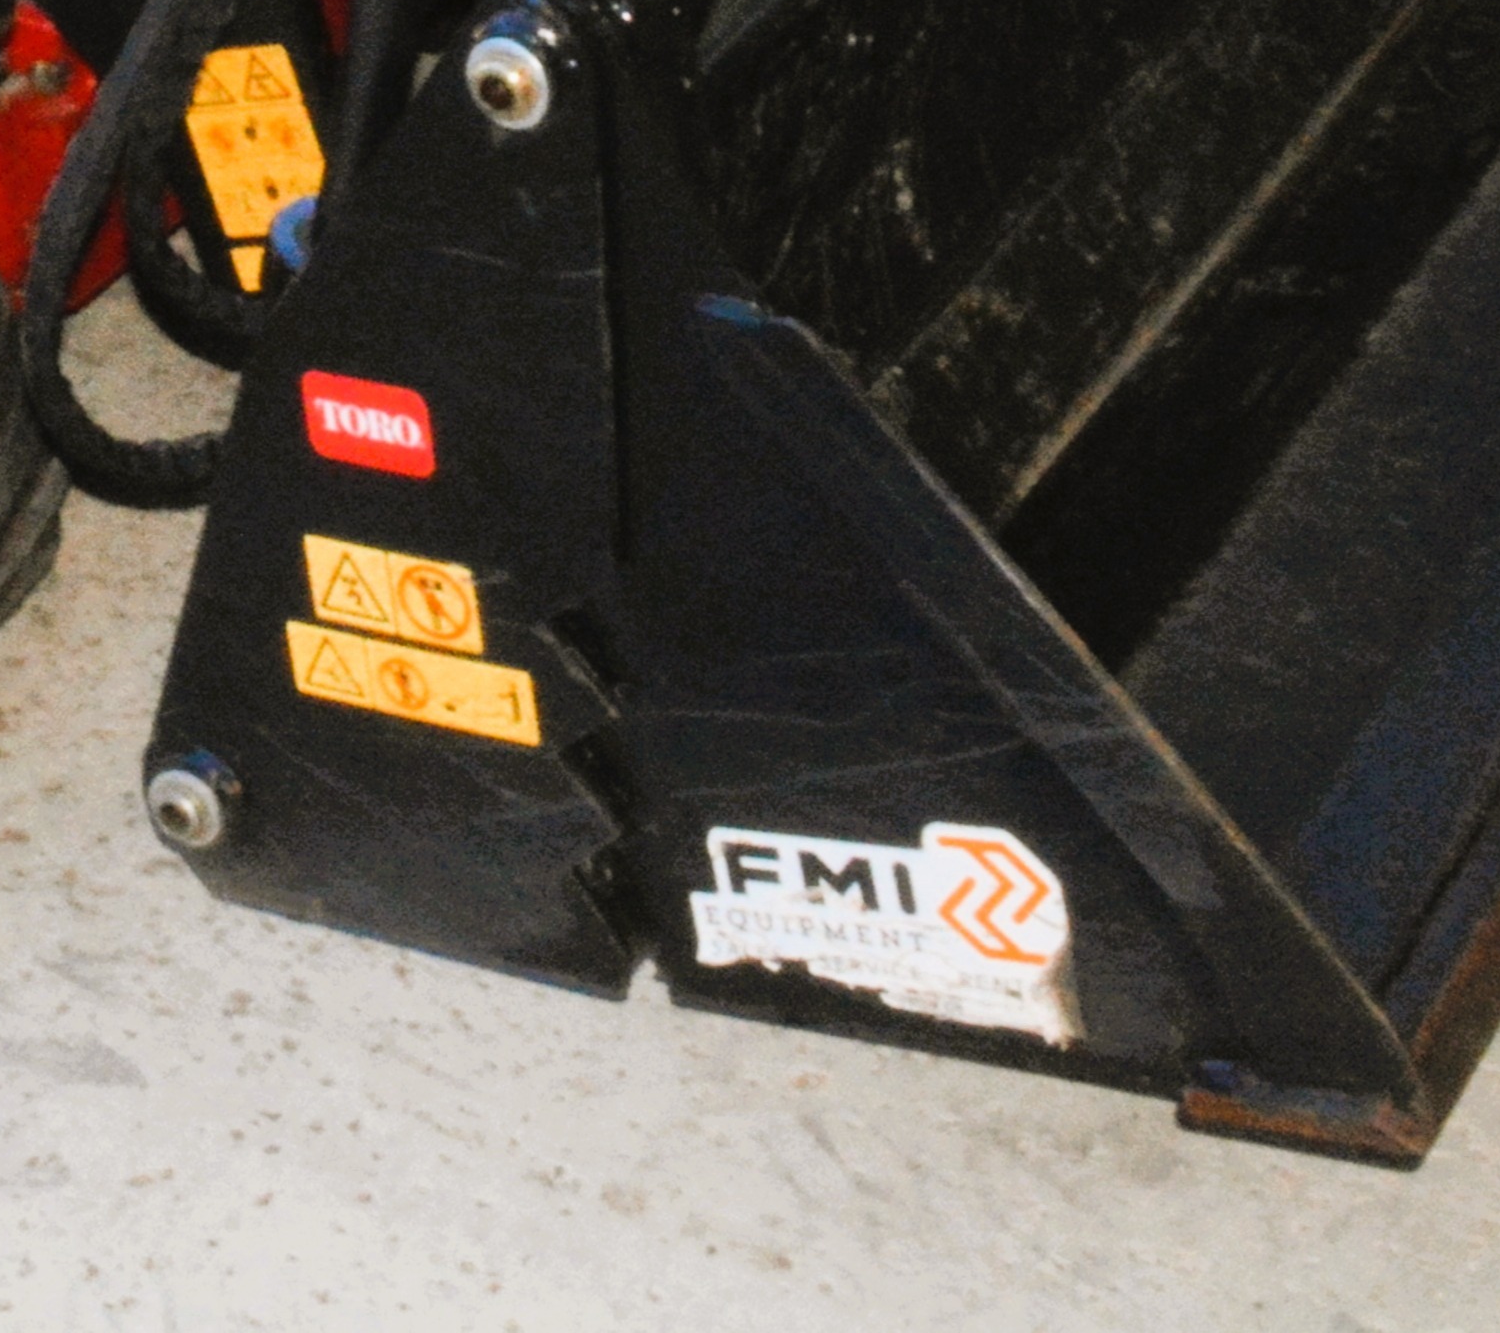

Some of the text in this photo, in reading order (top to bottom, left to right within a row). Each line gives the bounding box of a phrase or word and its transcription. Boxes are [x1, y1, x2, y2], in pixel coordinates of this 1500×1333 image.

[314, 397, 423, 450] TORO
[721, 841, 917, 916] FMI
[705, 905, 928, 953] EQUIPMENT
